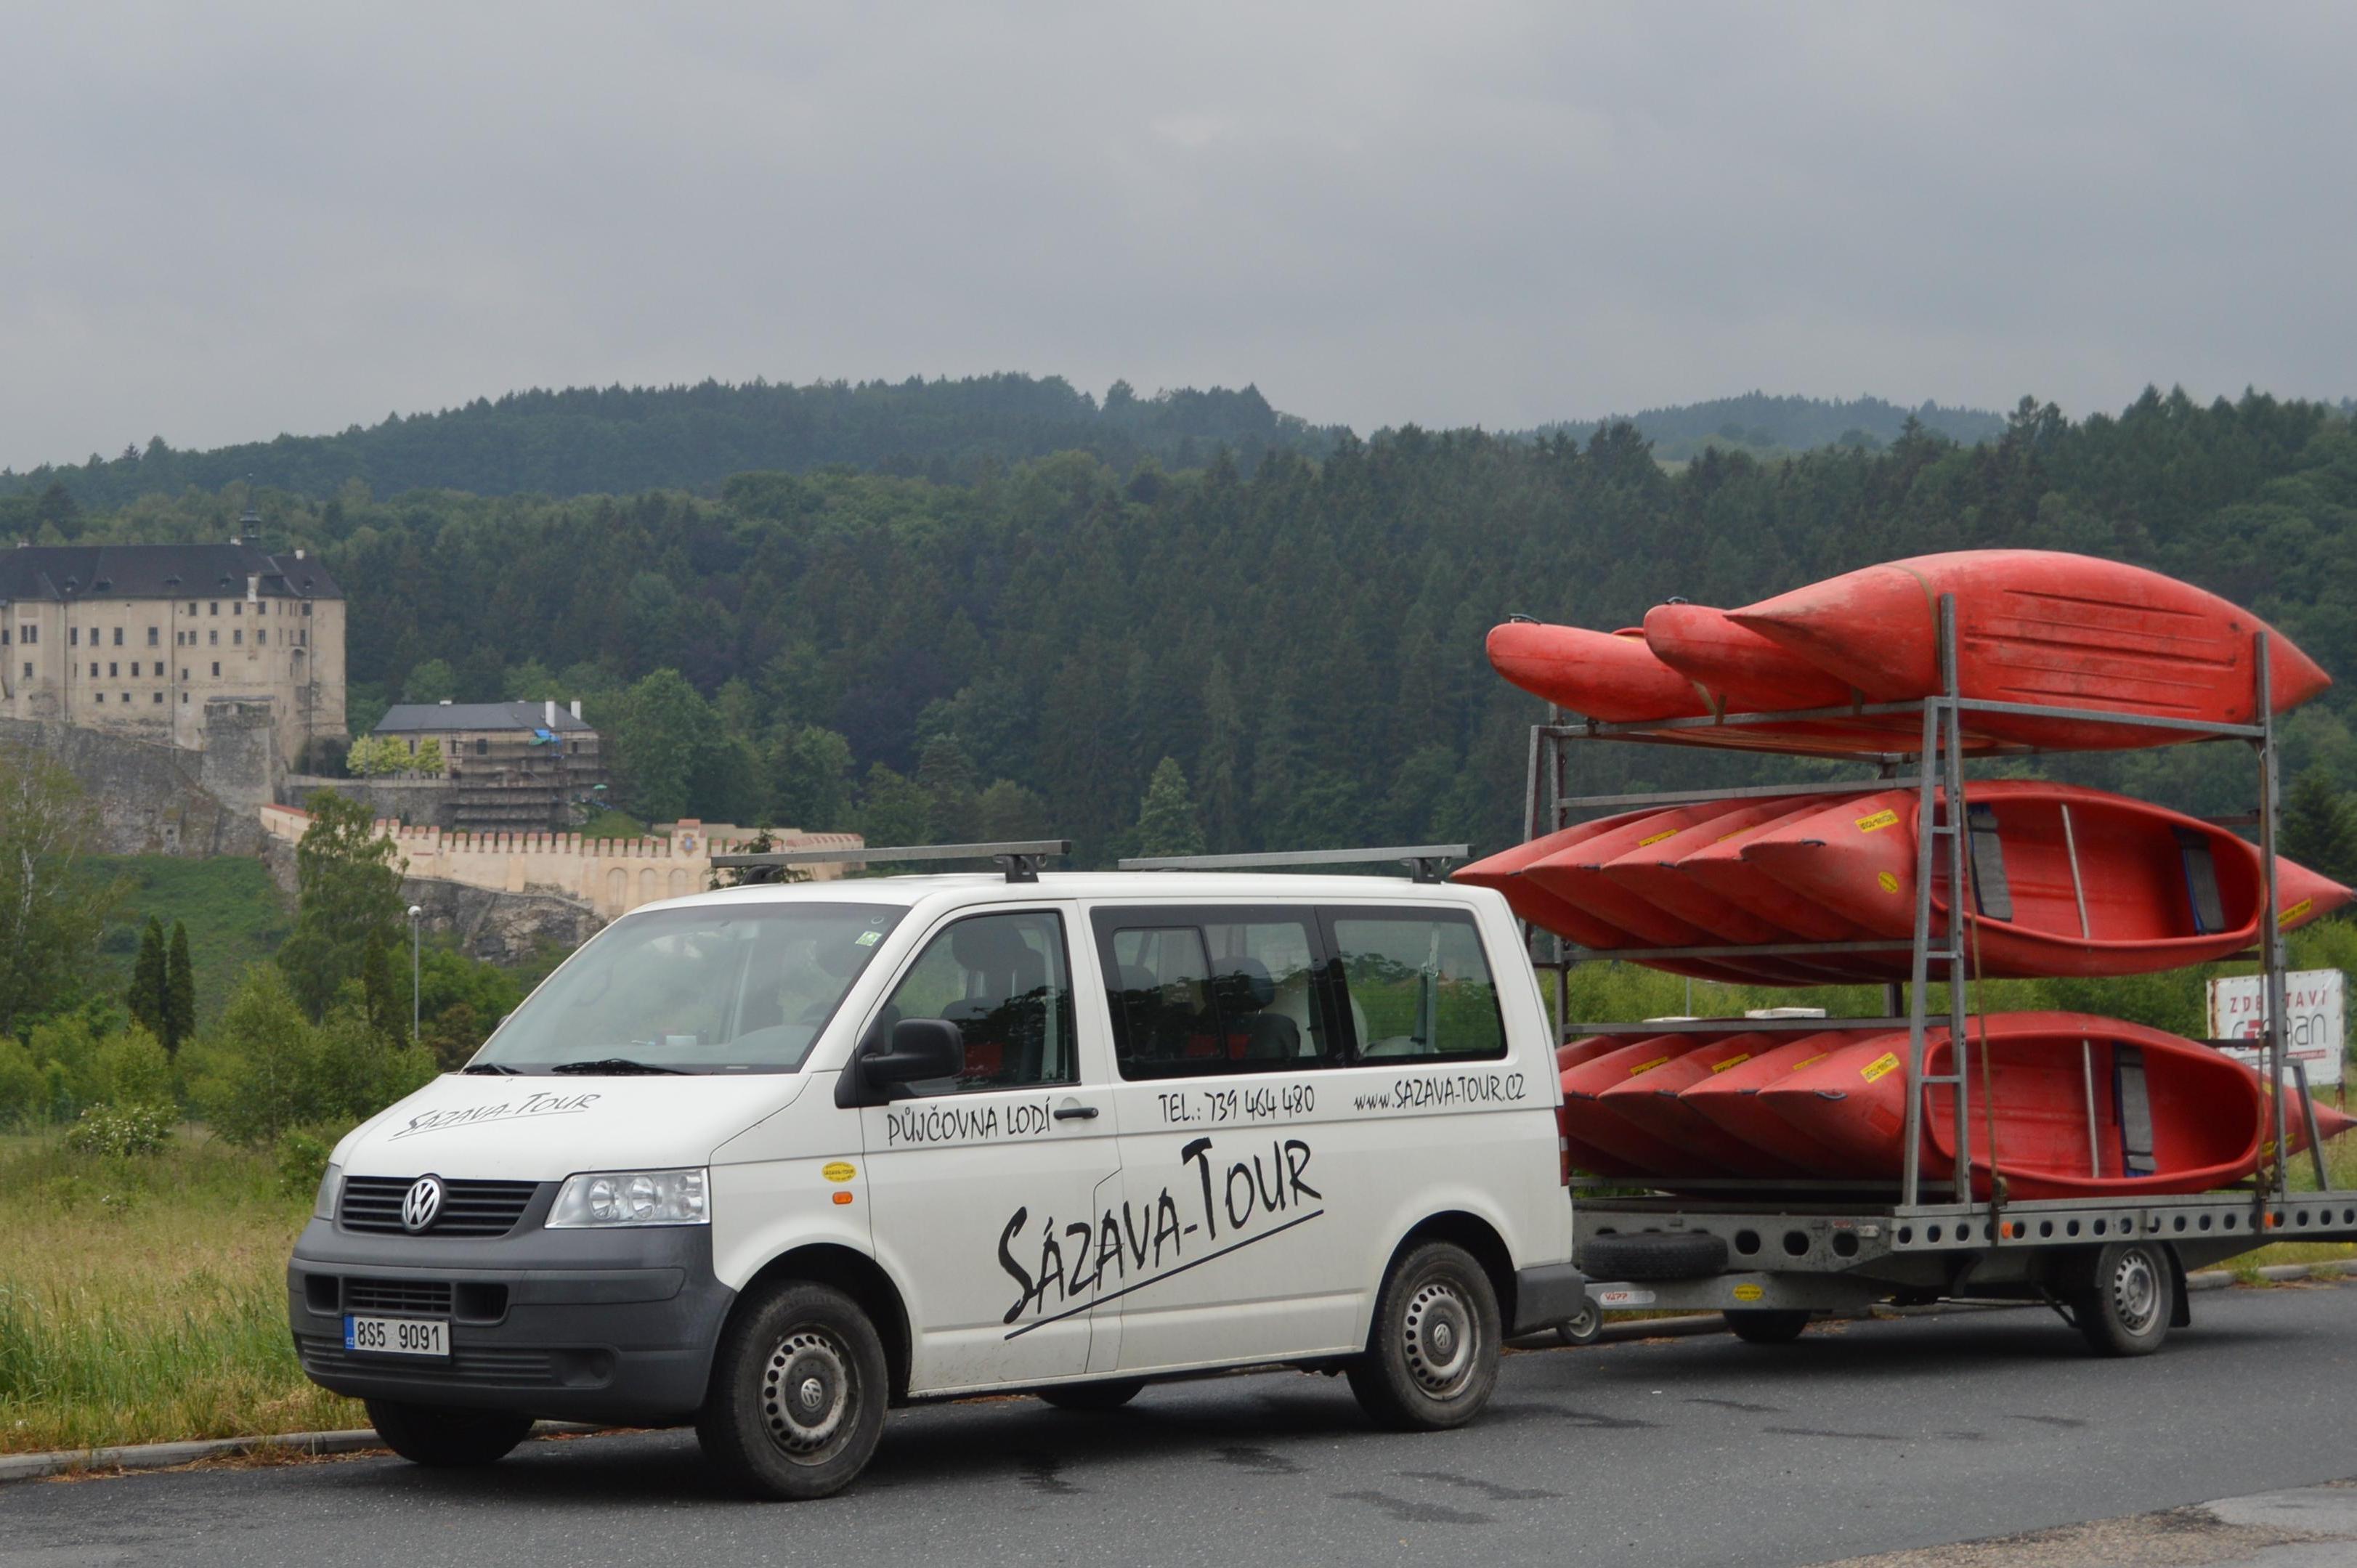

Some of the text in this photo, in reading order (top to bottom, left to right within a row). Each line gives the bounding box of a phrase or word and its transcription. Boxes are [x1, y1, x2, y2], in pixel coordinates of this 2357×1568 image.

[1159, 1084, 1315, 1123] TEL.: 739 464 480
[1354, 1073, 1526, 1110] www.SAZAVA-TOUR.CZ
[887, 1096, 1051, 1147] PŮJČOVNA LODÍ
[357, 1321, 386, 1347] 8S5
[399, 1324, 439, 1351] 9091
